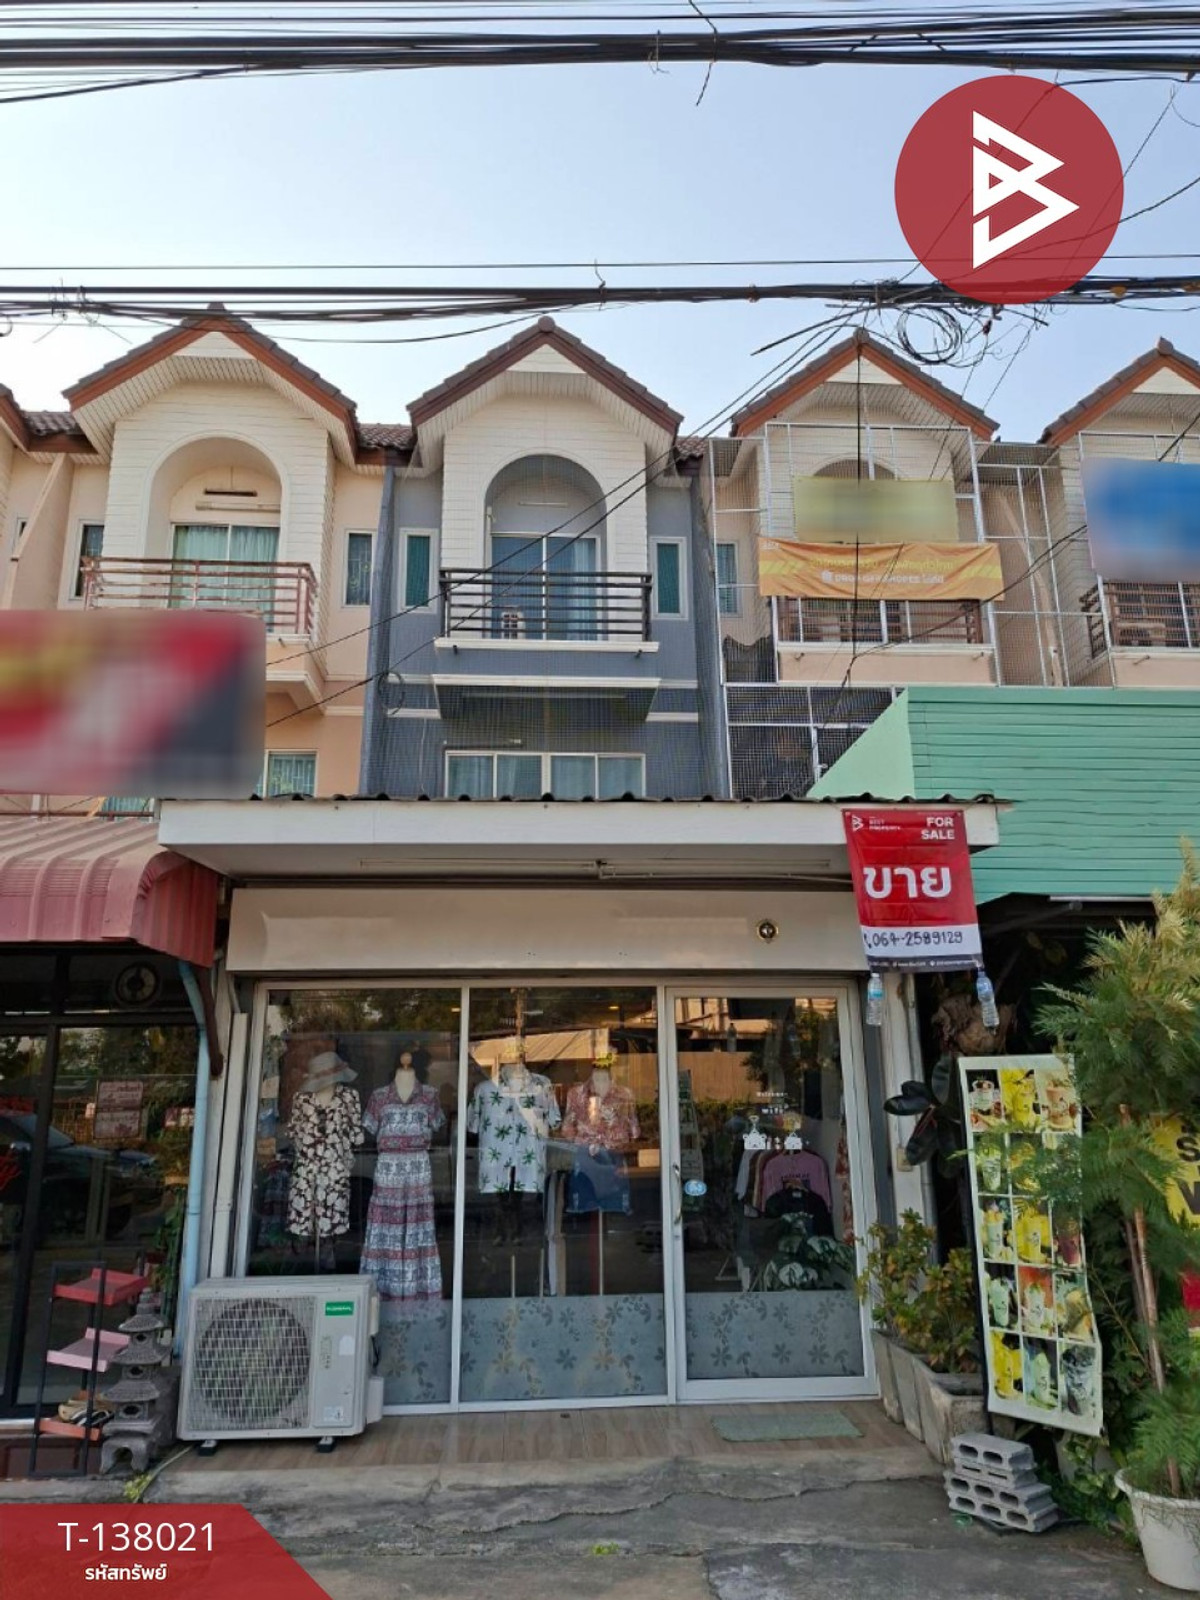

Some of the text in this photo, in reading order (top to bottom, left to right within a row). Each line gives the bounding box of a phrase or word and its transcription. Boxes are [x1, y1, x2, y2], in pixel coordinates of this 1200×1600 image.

[926, 817, 954, 828] FOR
[921, 828, 955, 840] SALE
[863, 866, 952, 898] ขาย
